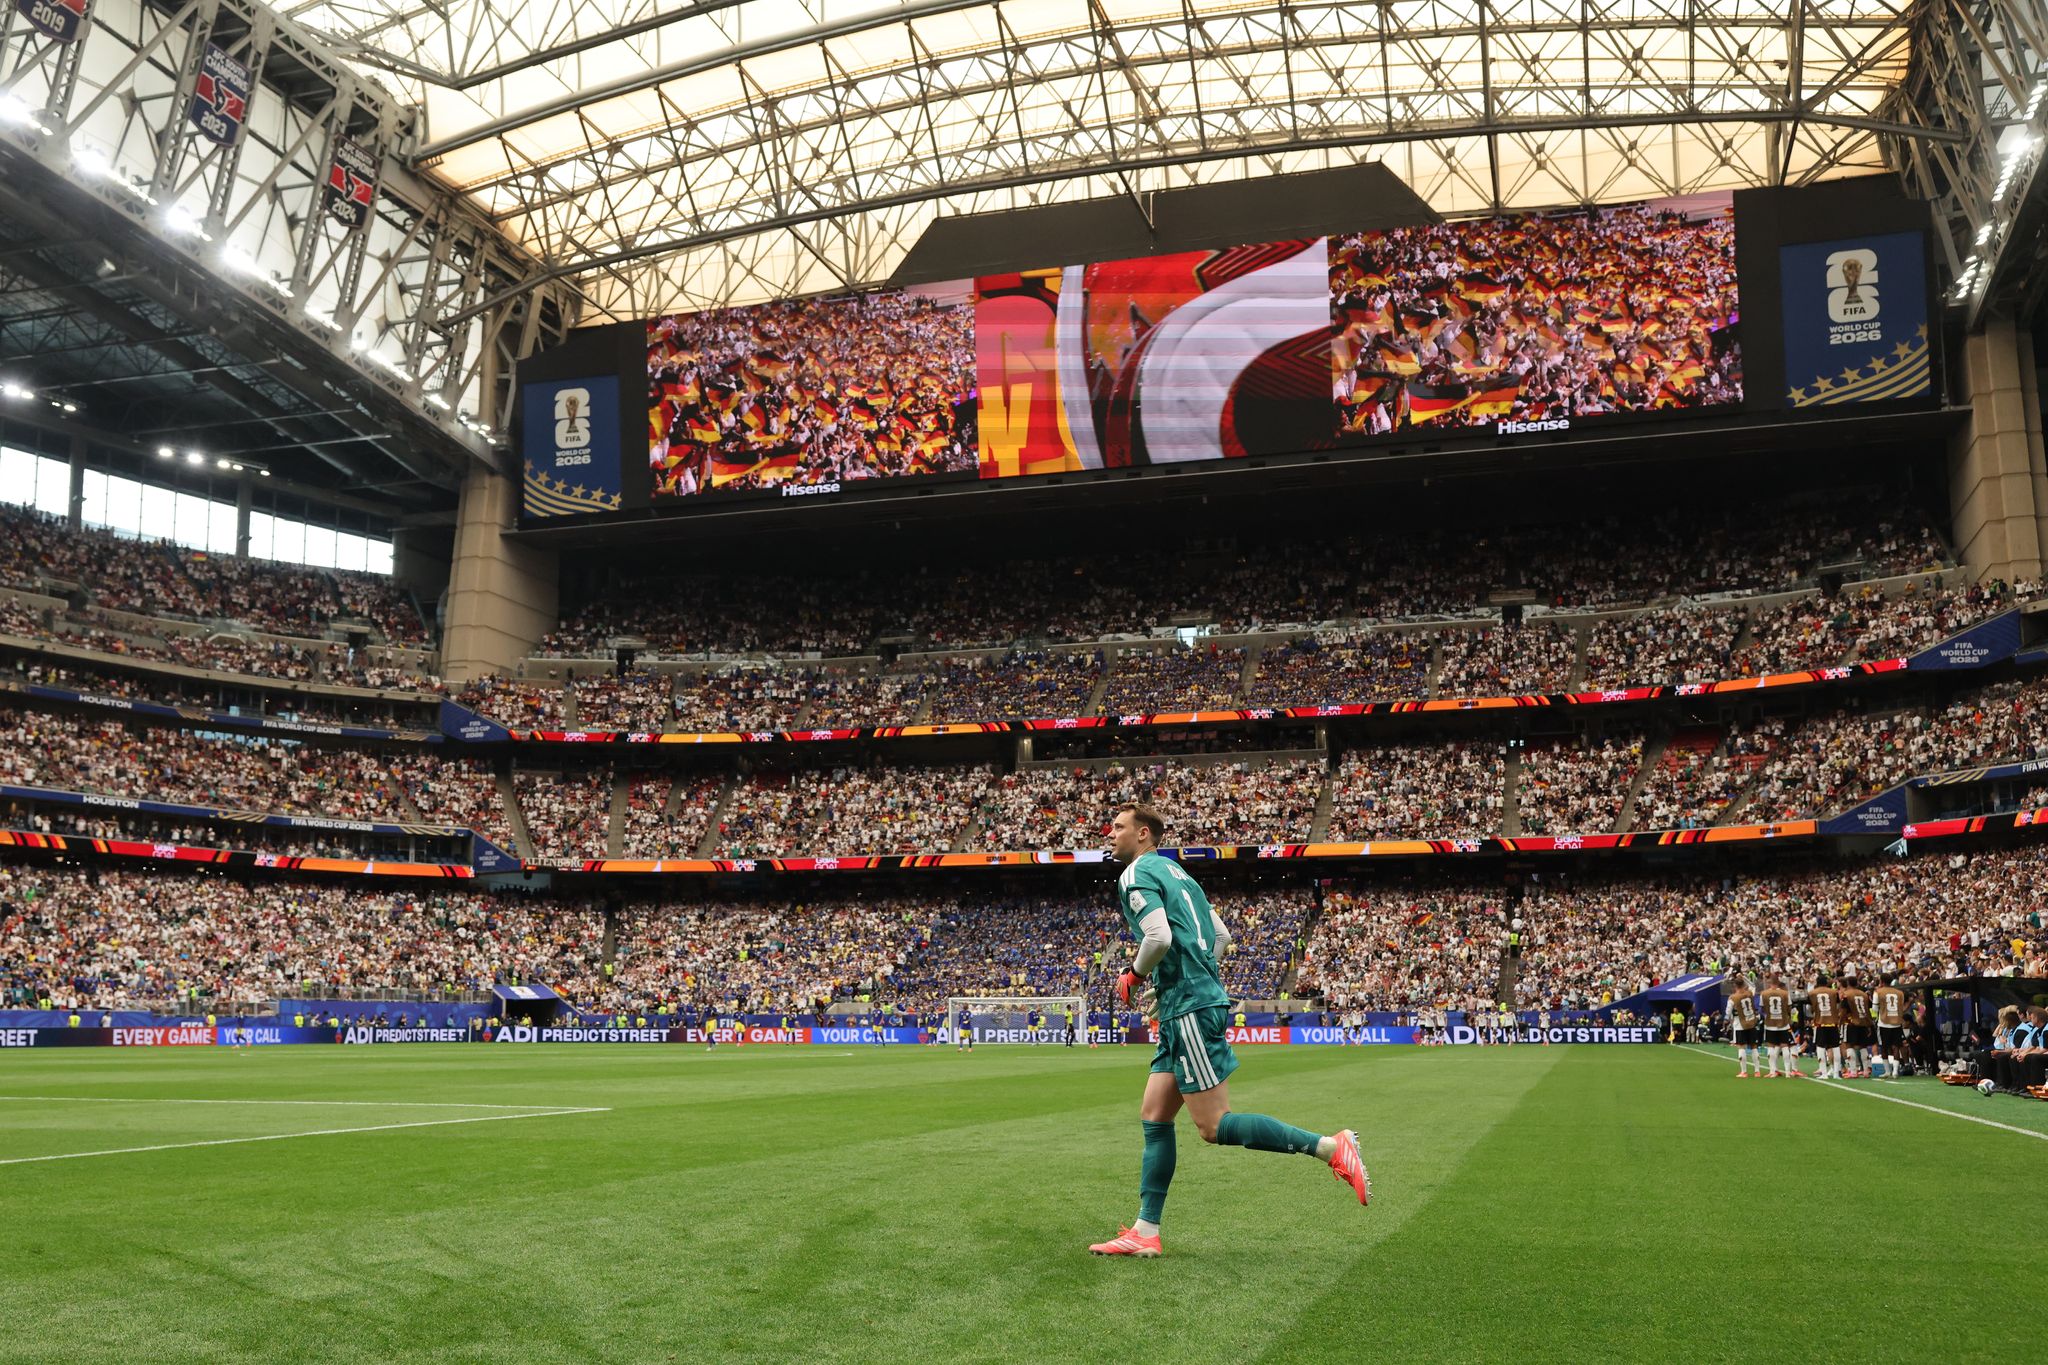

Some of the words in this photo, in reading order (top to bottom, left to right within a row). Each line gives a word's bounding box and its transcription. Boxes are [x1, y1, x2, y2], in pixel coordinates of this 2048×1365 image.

[31, 1, 65, 32] 2019
[206, 55, 248, 92] CHAMPIONS
[201, 111, 227, 138] 2023
[338, 147, 375, 178] CHAMPIONS
[332, 197, 356, 223] 2024
[1843, 306, 1866, 316] FIFA
[1829, 323, 1862, 333] WORLD
[1863, 321, 1881, 330] CUP
[1829, 329, 1882, 345] 2026
[1497, 419, 1570, 435] Hisense
[565, 434, 582, 443] FIFA
[555, 454, 592, 467] 2026
[782, 482, 841, 497] Hisense
[1949, 656, 1979, 664] 2026
[79, 694, 132, 709] HOUSTON
[263, 720, 278, 728] FIFA
[279, 722, 302, 731] WORLD
[303, 724, 316, 732] CUP
[2022, 763, 2038, 773] FIFA
[83, 795, 139, 809] HOUSTON
[291, 818, 308, 826] FIFA
[308, 820, 333, 829] WORLD
[333, 821, 349, 829] CUP
[1181, 888, 1208, 951] 1
[112, 1029, 165, 1045] EVERY
[167, 1028, 212, 1045] GAME
[255, 1029, 281, 1043] CALL
[344, 1026, 373, 1044] ADI
[375, 1028, 466, 1042] PREDICTSTREET
[496, 1026, 538, 1043] ADI
[542, 1028, 670, 1042] PREDICTSTREET
[821, 1029, 862, 1042] YOUR
[1225, 1028, 1281, 1043] GAME
[1301, 1028, 1344, 1043] YOUR
[1349, 1028, 1390, 1043] CALL
[1179, 1055, 1195, 1083] 1
